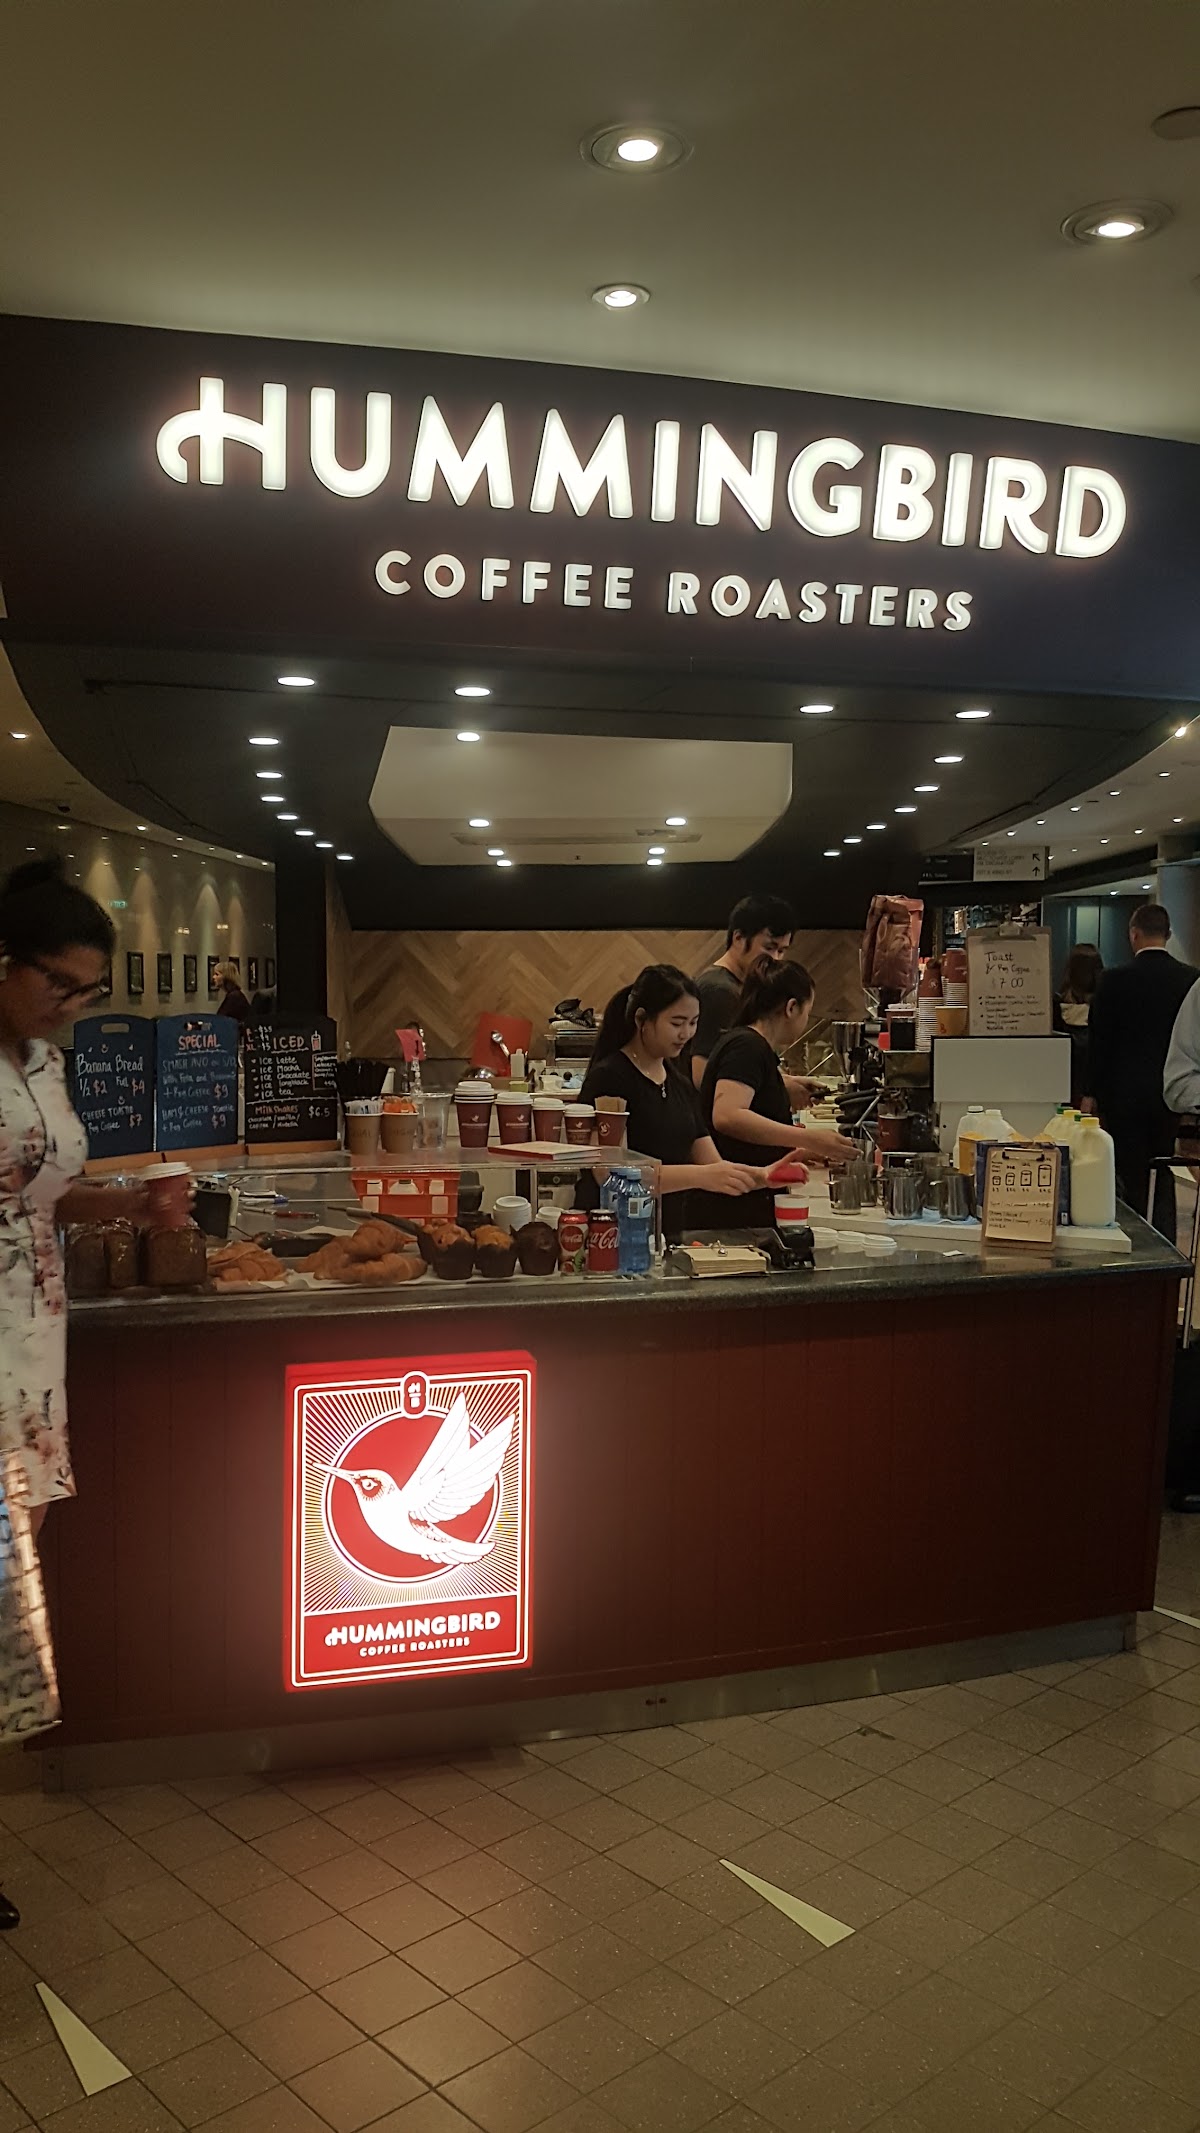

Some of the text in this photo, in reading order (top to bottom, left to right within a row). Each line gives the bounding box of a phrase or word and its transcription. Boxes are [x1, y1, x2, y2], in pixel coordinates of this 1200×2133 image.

[156, 377, 1127, 558] HUMMINGBIRD
[375, 549, 973, 631] COFFEE ROASTERS
[984, 952, 1014, 962] Toast
[178, 1034, 221, 1050] SPECIAL
[273, 1035, 304, 1050] ICED
[76, 1053, 144, 1076] Banana Bread
[214, 1083, 228, 1100] $9
[308, 1105, 330, 1118] $6.5
[212, 1114, 226, 1130] $9
[324, 1611, 501, 1647] HUMMINGBIRD
[359, 1636, 471, 1657] COFFEE ROASTERS
